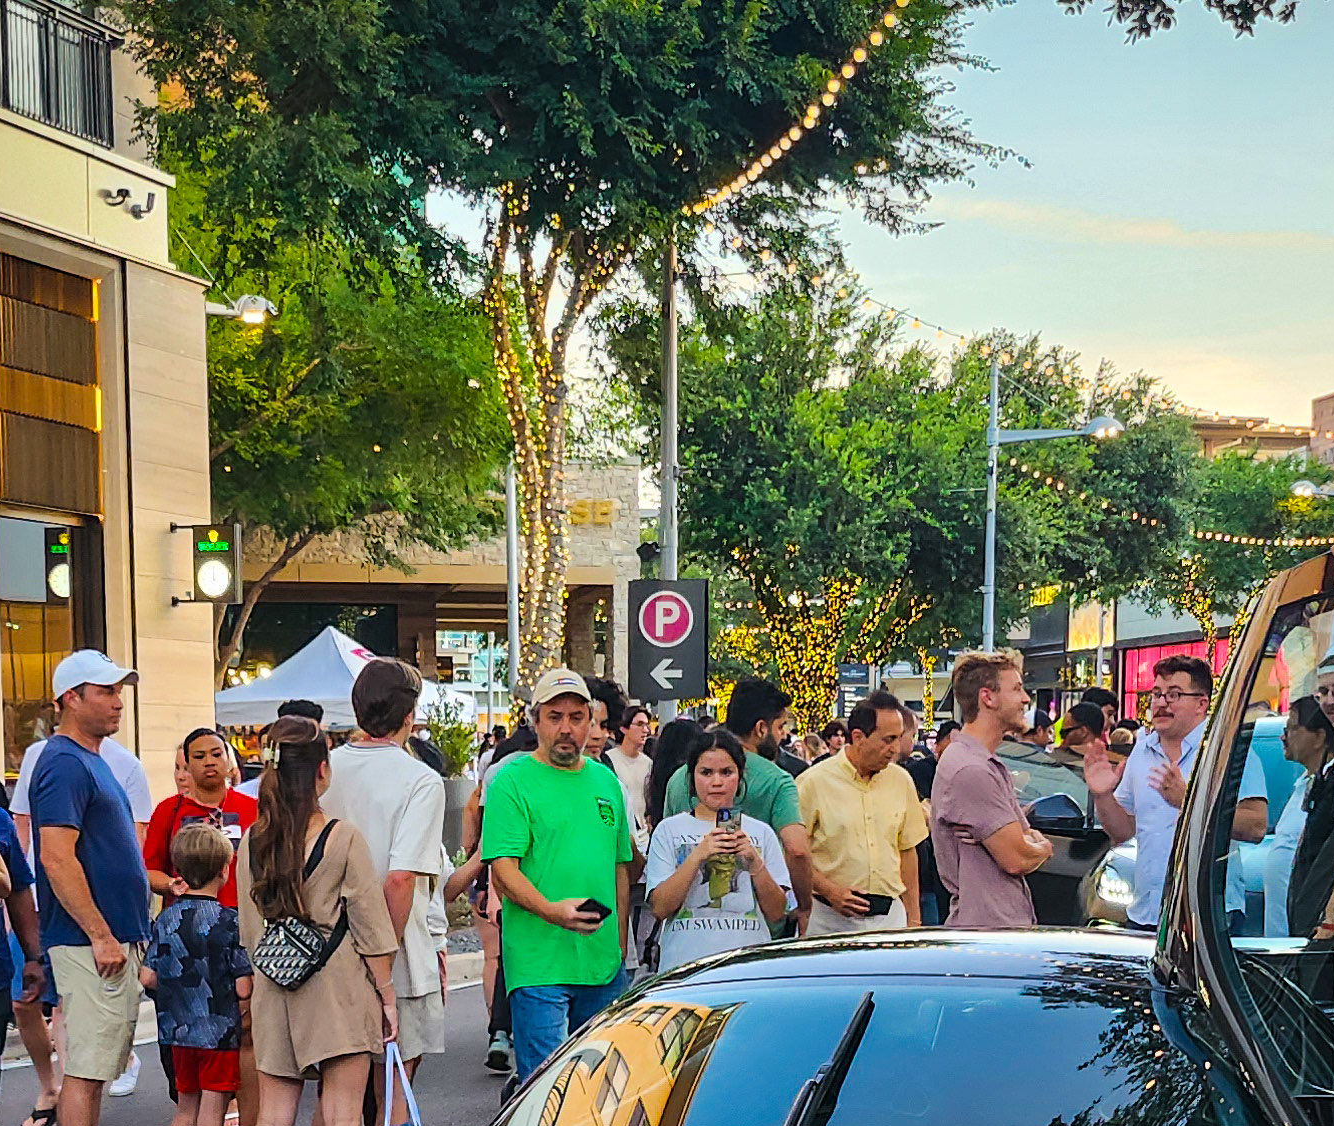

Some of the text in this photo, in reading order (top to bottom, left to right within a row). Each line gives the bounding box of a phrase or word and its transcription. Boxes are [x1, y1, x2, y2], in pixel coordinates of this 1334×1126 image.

[655, 601, 681, 637] P
[671, 918, 762, 932] I'M SWAMPED
